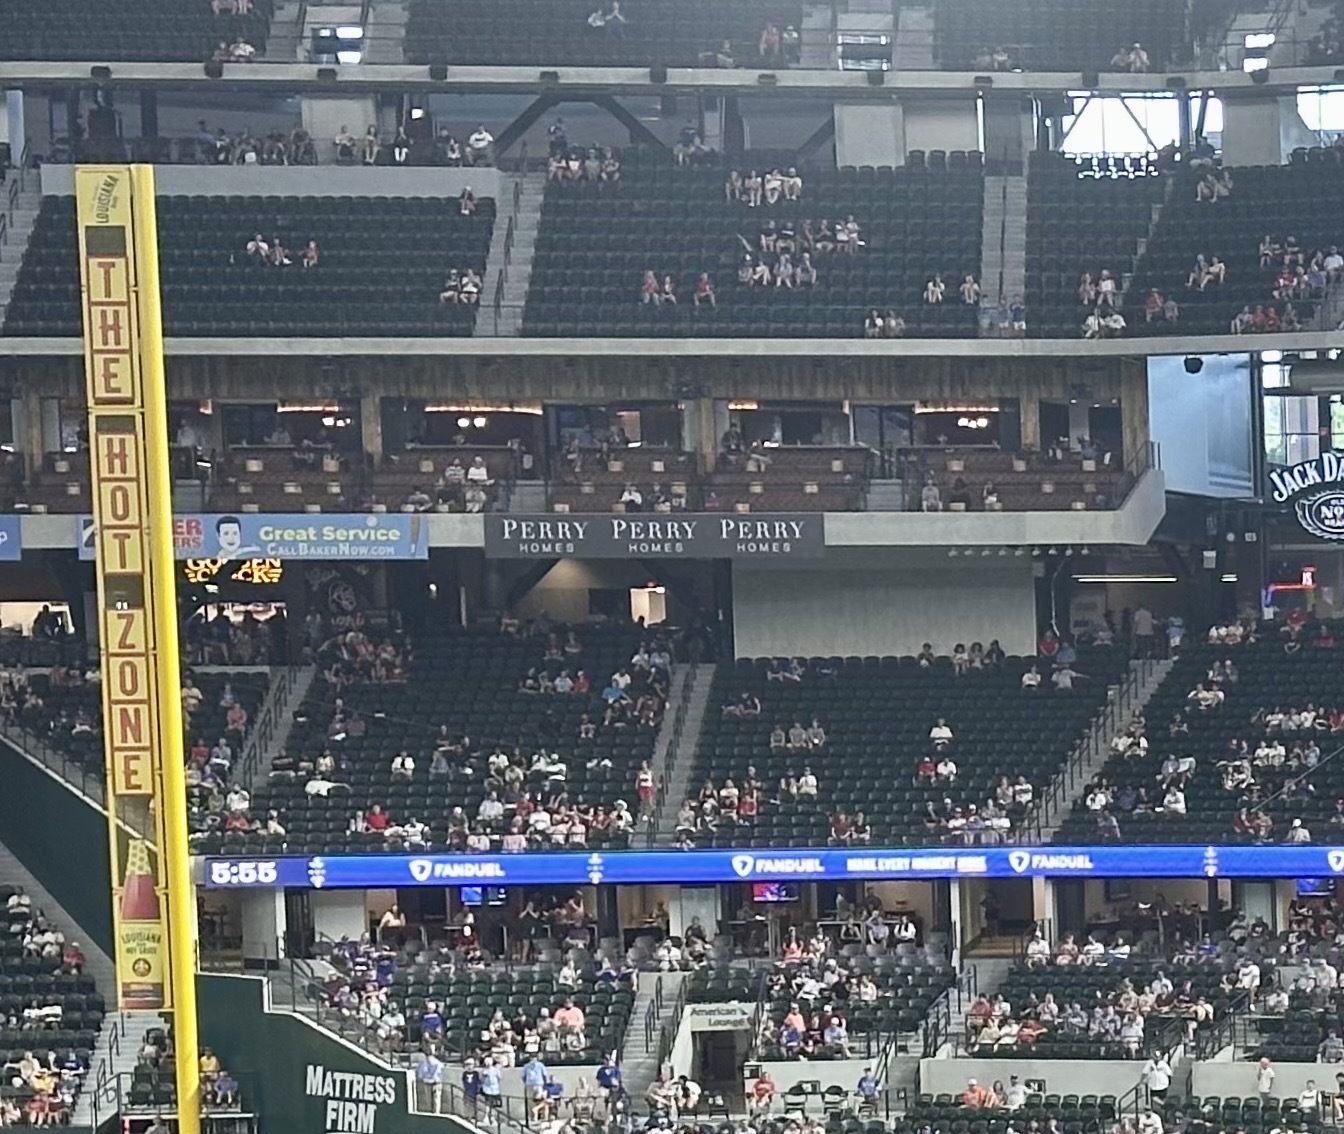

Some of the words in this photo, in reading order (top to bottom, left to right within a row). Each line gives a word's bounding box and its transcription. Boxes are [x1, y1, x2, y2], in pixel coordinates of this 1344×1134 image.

[96, 175, 119, 224] LOUISIANA
[98, 261, 122, 394] THE
[1269, 461, 1322, 502] JACK
[105, 437, 130, 569] HOT
[173, 519, 201, 535] ER
[259, 526, 318, 542] Great
[322, 526, 401, 542] Service
[502, 518, 589, 540] PERRY
[612, 518, 698, 540] PERRY
[720, 518, 806, 540] PERRY
[519, 543, 575, 554] HOMES
[629, 543, 684, 554] HOMES
[737, 543, 791, 554] HOMES
[117, 613, 141, 791] ZONE
[211, 861, 277, 884] 5:55
[434, 862, 506, 878] FANDUEL
[755, 858, 825, 872] FANDUEL
[1032, 855, 1094, 869] FANDUEL
[690, 1007, 736, 1016] American
[305, 1065, 396, 1105] MATTRESS
[325, 1100, 377, 1134] FIRM
